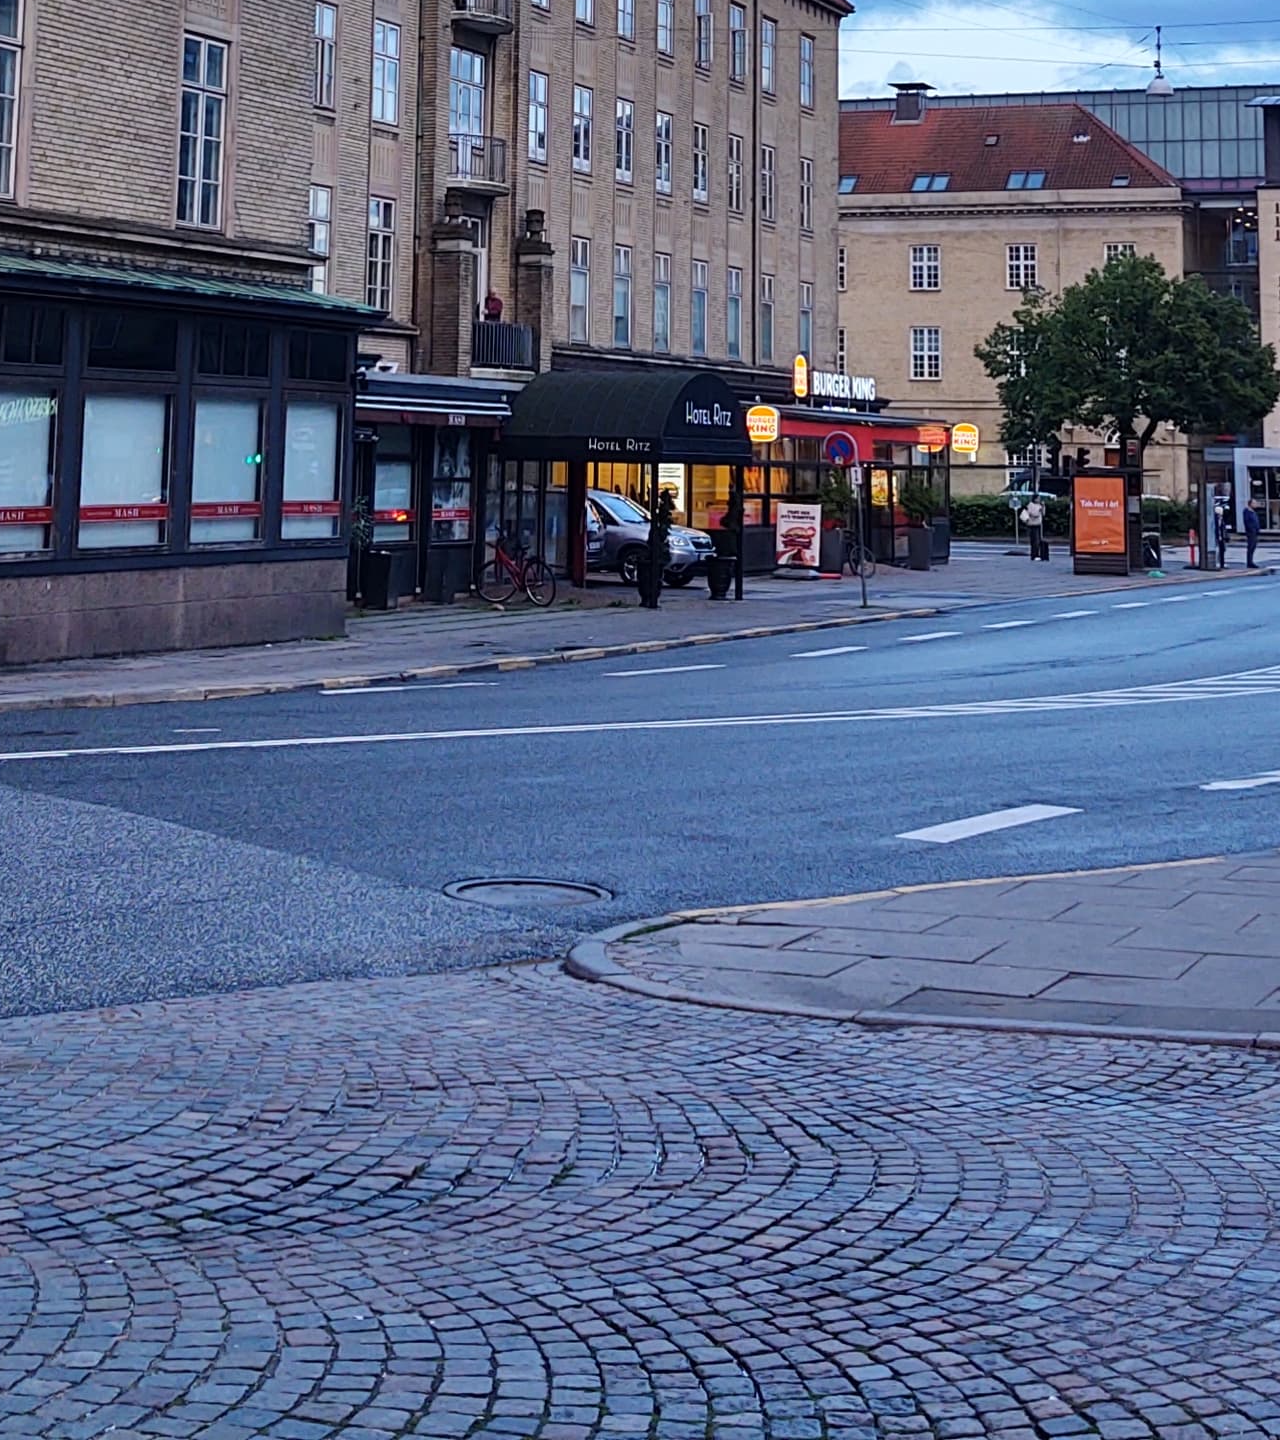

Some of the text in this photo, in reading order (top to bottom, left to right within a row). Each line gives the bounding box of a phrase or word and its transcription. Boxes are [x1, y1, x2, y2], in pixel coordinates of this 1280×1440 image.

[813, 371, 851, 399] BURGER
[852, 375, 875, 401] KING
[748, 424, 776, 433] KING
[113, 508, 140, 518] MASH
